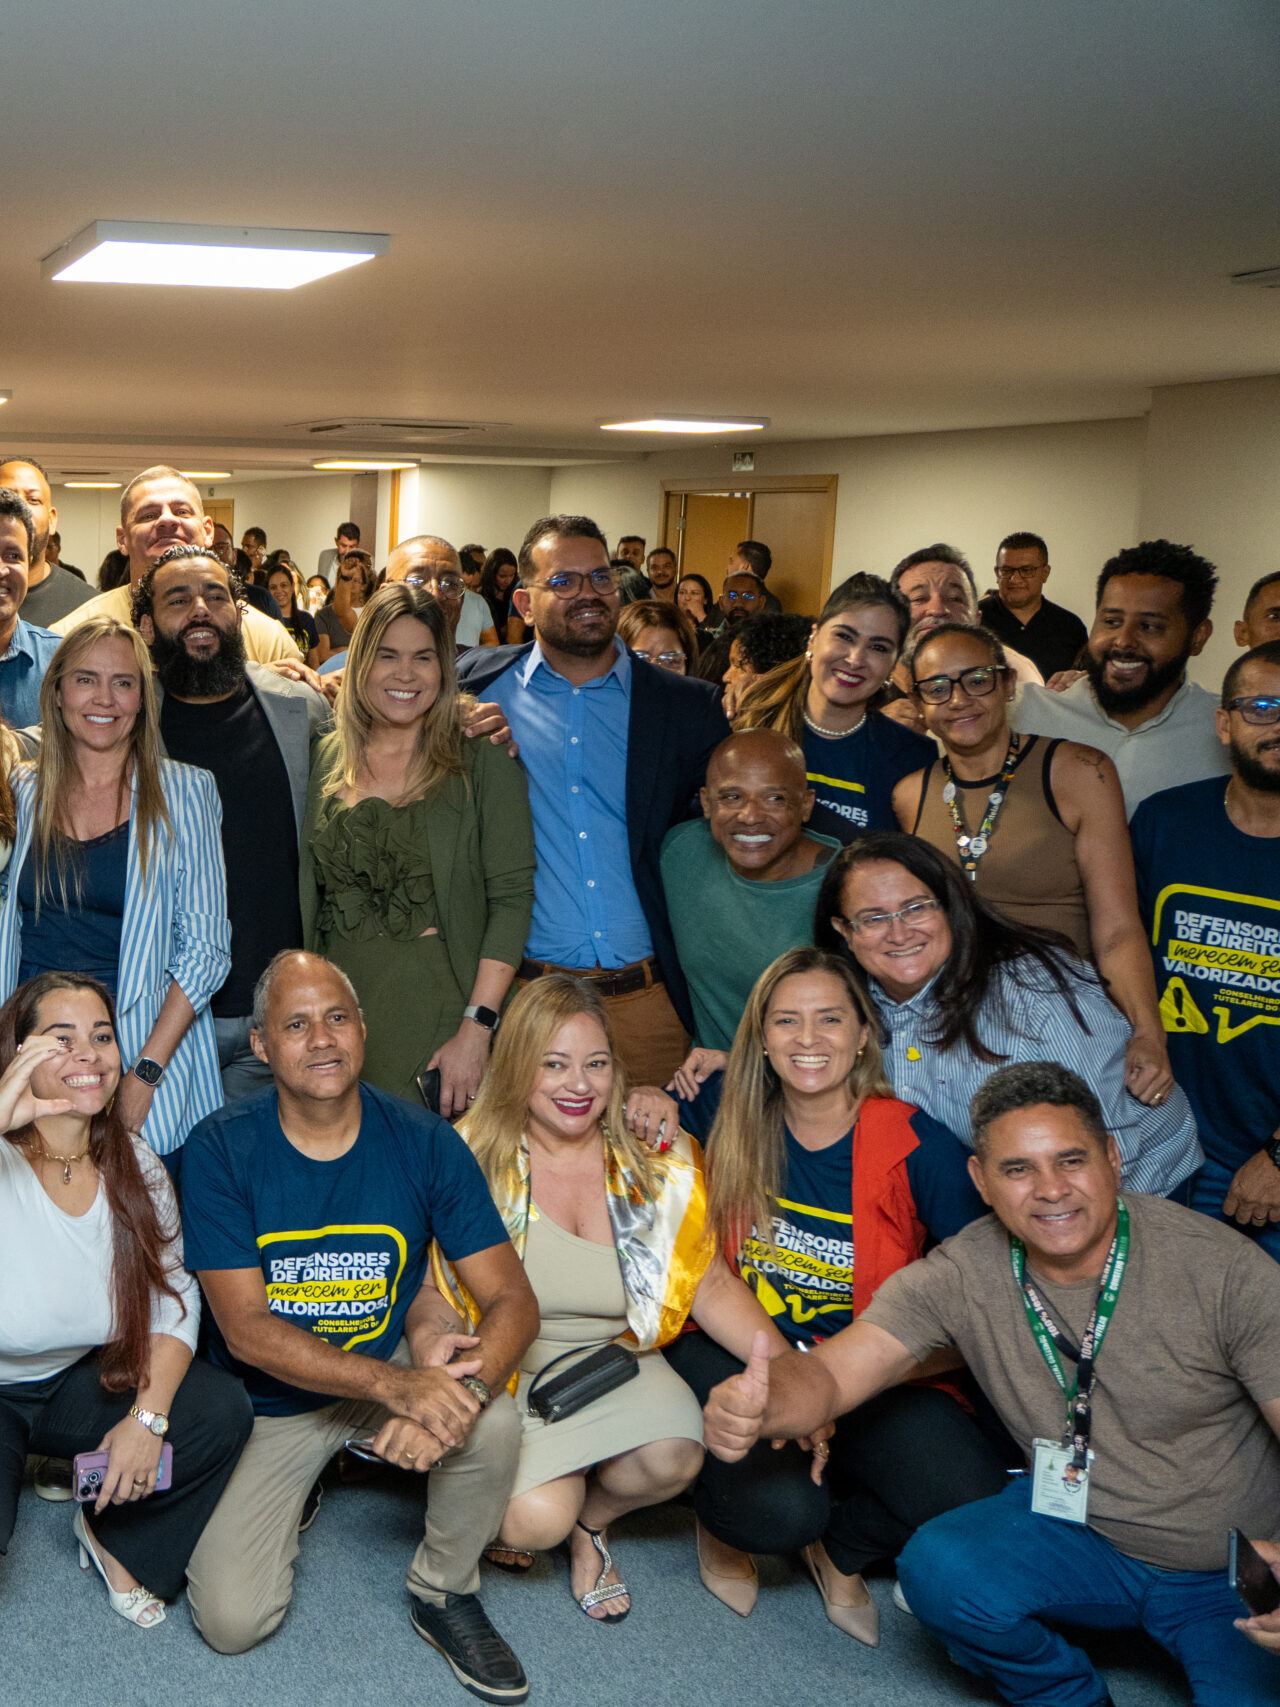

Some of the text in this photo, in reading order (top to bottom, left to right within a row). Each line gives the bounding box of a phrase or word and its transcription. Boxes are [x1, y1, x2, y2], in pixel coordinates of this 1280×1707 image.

[1174, 909, 1280, 944] DEFENSOR
[1176, 924, 1280, 958] DE DIREITO
[1174, 944, 1280, 975] merecem se
[1162, 956, 1280, 994] VALORIZADO
[1213, 993, 1279, 1012] TUTELARES DO
[1219, 988, 1280, 1005] CONSELHEIRO
[772, 1216, 854, 1256] FENSORE
[270, 1252, 391, 1273] DEFENSORES
[272, 1266, 386, 1284] DE DIREITOS
[753, 1258, 854, 1293] LORIZADO
[270, 1282, 382, 1299] merecem ser
[312, 1325, 359, 1334] TUTELARES
[1040, 1311, 1060, 1338] 100%
[1081, 1334, 1094, 1361] 100%
